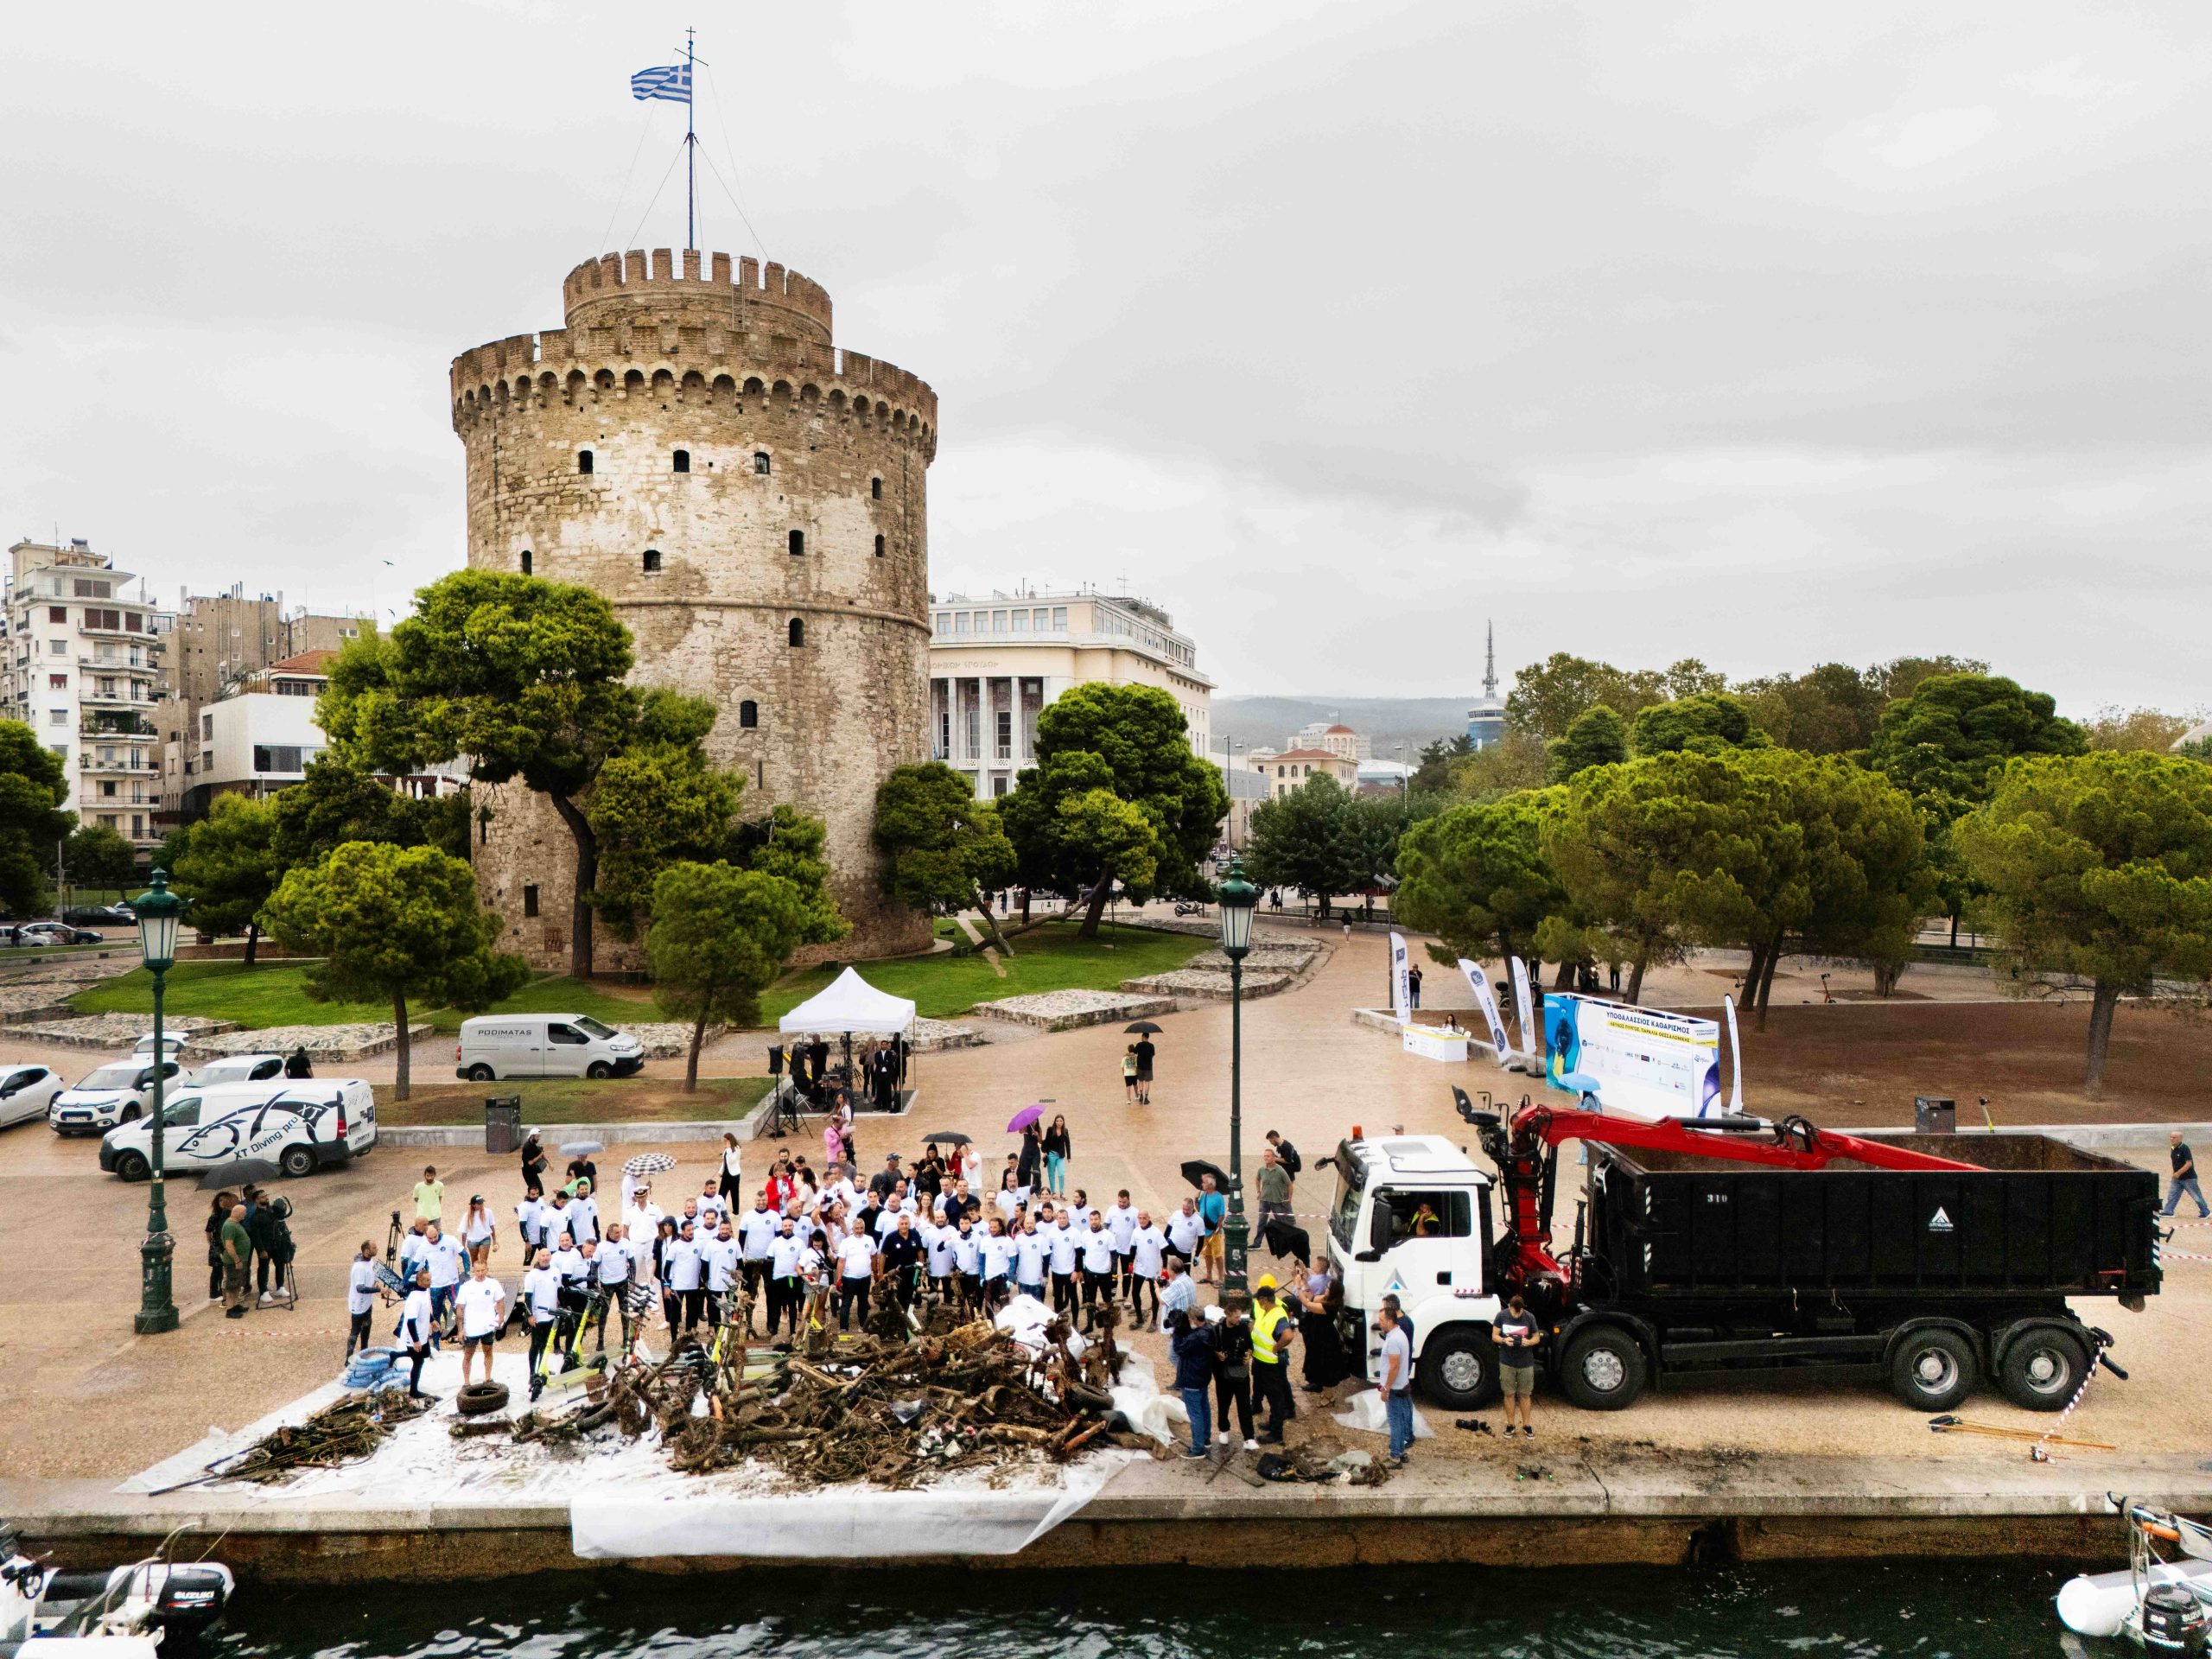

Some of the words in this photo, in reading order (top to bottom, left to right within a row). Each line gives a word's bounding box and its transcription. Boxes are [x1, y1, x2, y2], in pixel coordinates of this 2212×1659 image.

[1606, 1011, 1650, 1026] ΥΠΟΘΑΛΑΣΣΙΟΣ
[1650, 1020, 1690, 1034] ΚΑΘΑΡΙΣΜΟΣ
[298, 1104, 321, 1120] XT
[233, 1147, 248, 1161] XT
[250, 1130, 283, 1154] Diving
[282, 1116, 299, 1135] pro
[1707, 1194, 1728, 1203] 310
[174, 1591, 214, 1599] SUZUKI
